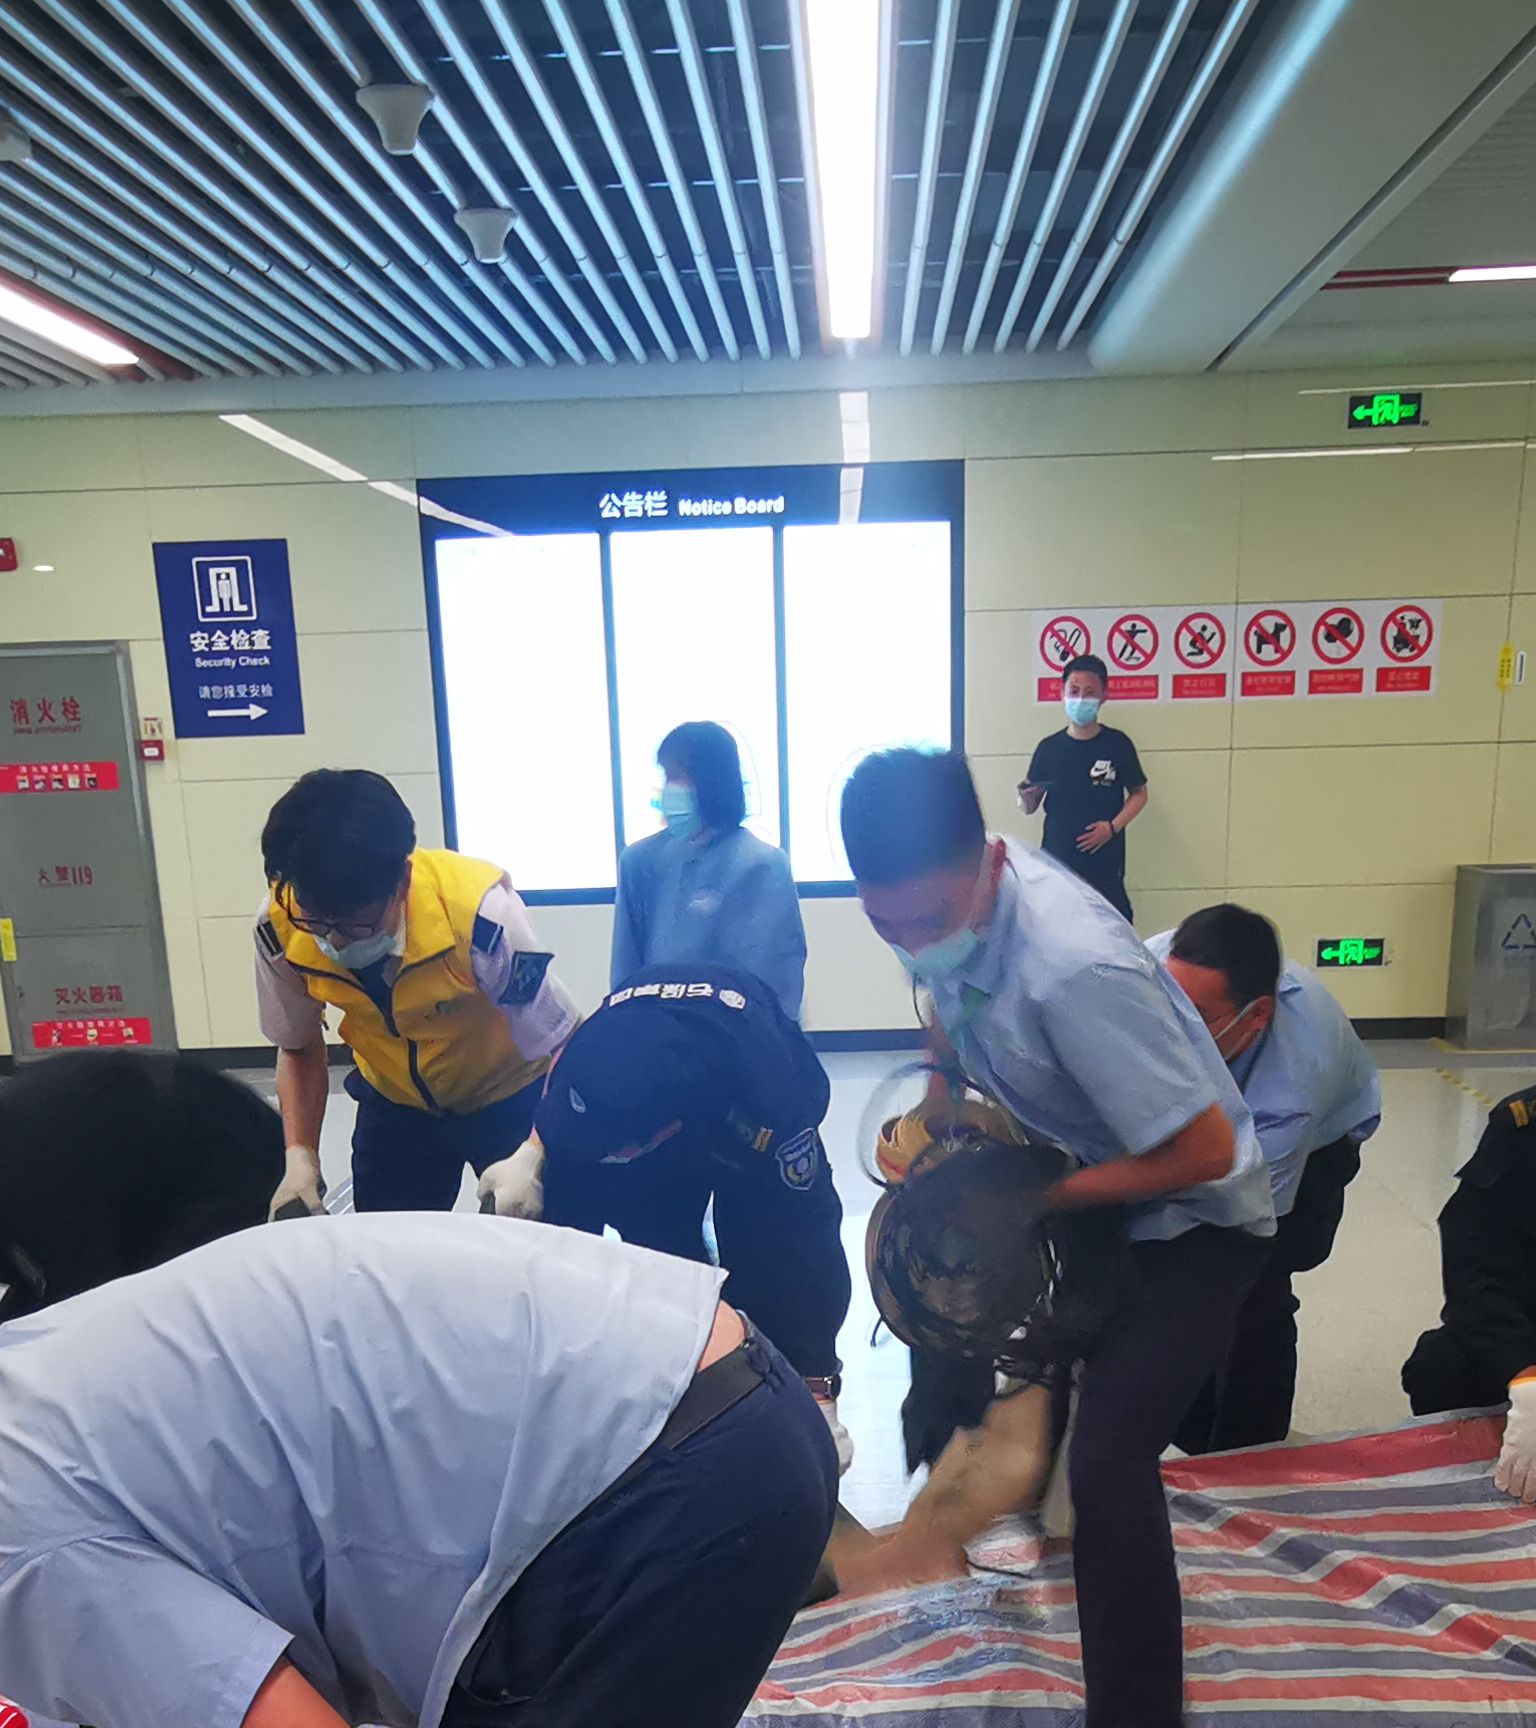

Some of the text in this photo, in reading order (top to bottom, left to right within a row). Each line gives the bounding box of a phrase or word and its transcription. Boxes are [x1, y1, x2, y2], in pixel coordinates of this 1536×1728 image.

[599, 490, 785, 518] 公告栏 Notice Board
[190, 629, 272, 652] 安全检查
[195, 656, 271, 670] Security Check
[199, 683, 273, 699] 请您接受安检
[10, 696, 81, 725] 消火栓
[38, 866, 94, 886] 火警119
[54, 985, 124, 1005] 灭火器箱
